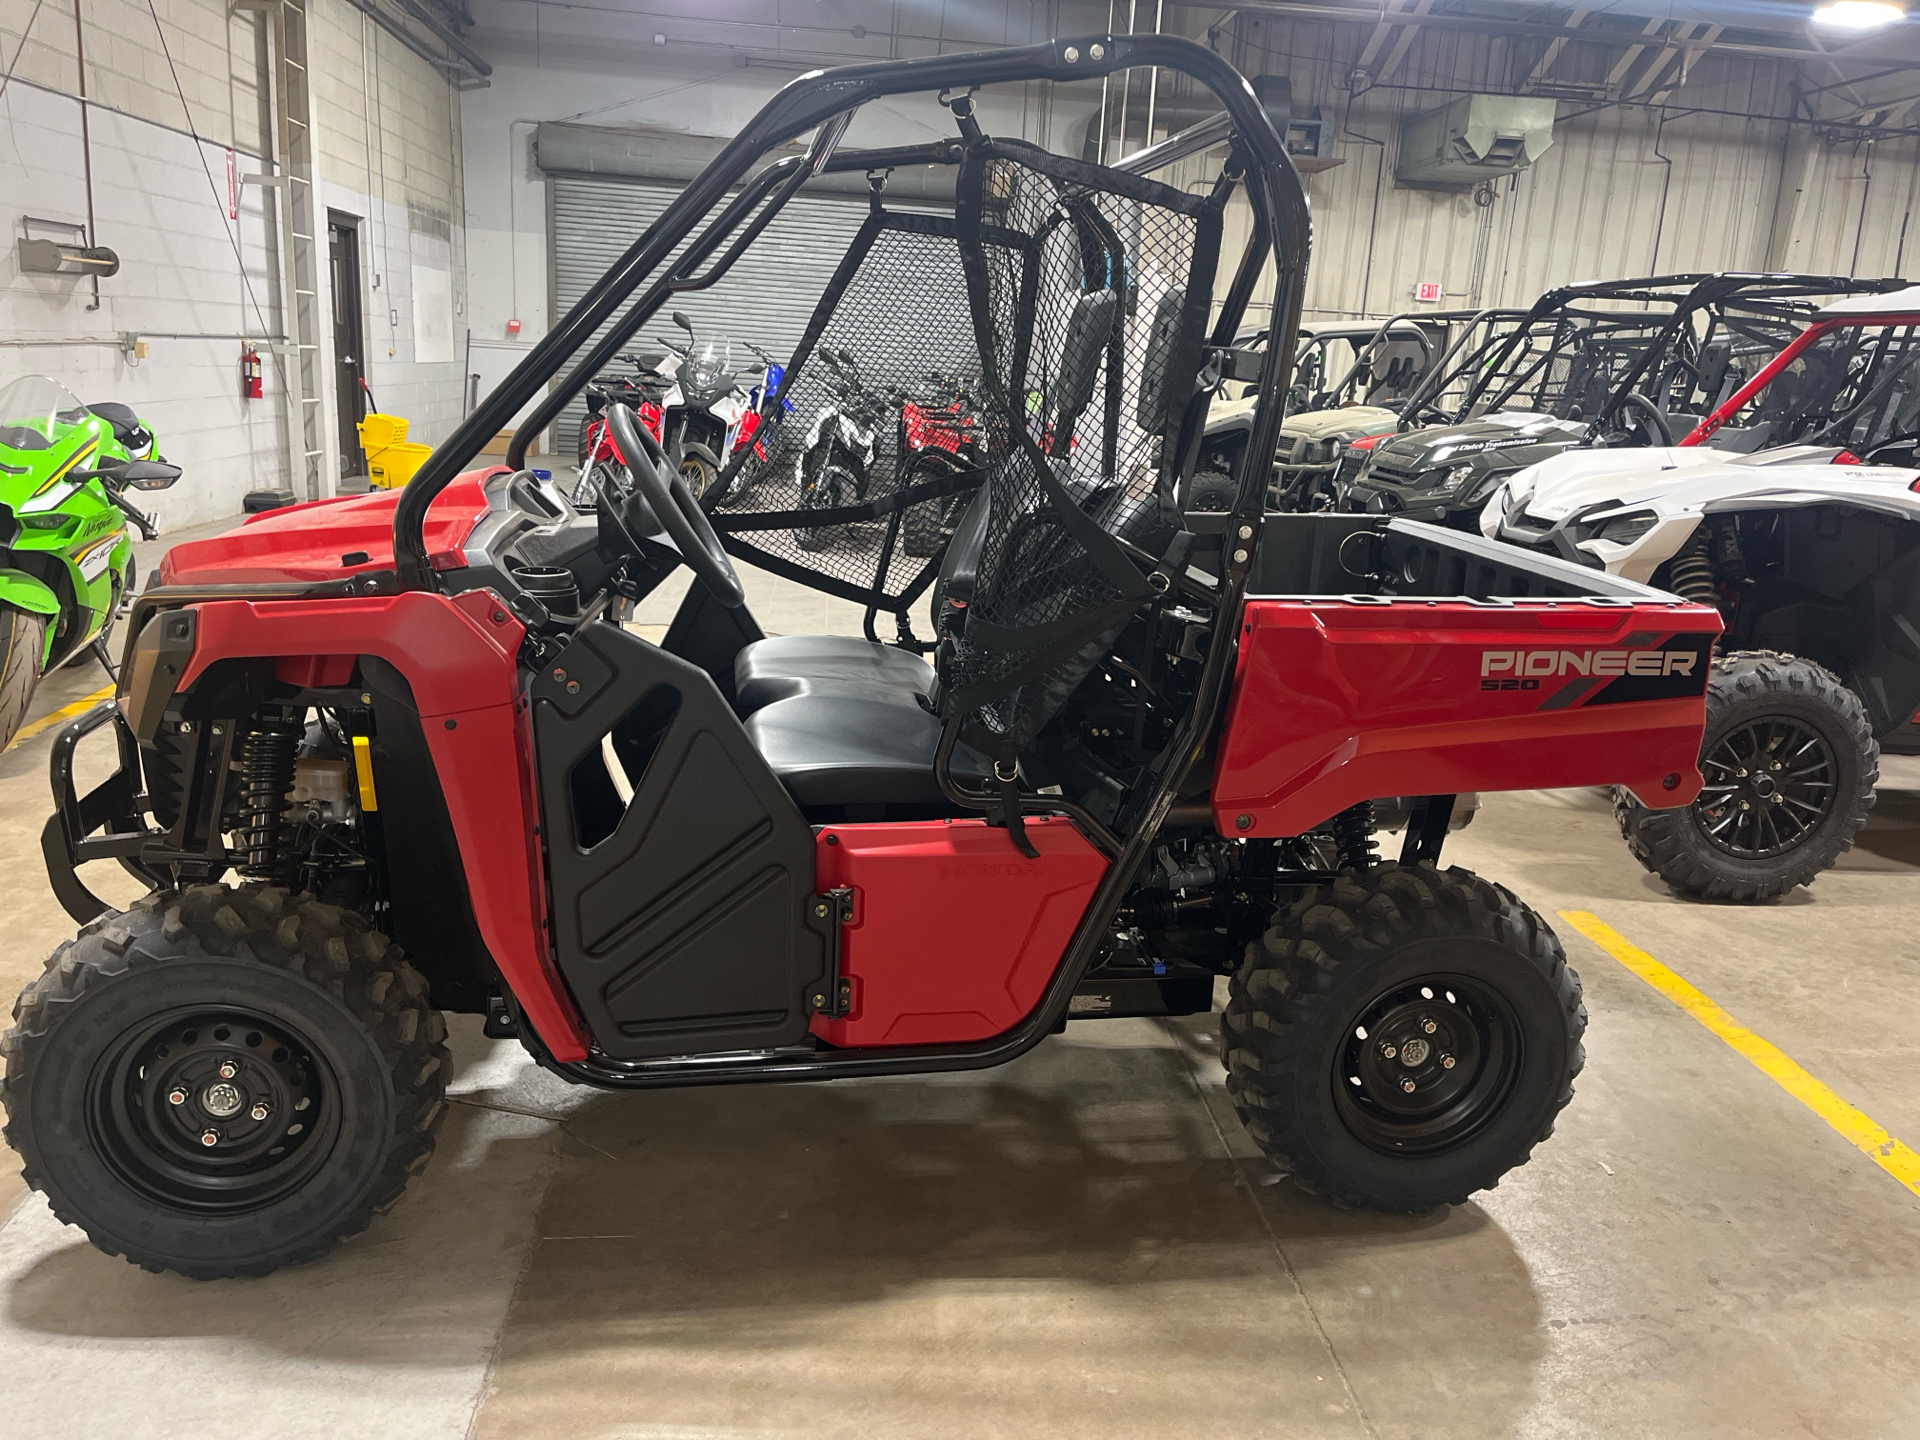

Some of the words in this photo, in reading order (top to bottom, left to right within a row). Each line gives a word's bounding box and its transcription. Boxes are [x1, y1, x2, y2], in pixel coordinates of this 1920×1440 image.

[1420, 283, 1439, 299] EXIT
[1459, 443, 1484, 451] Clutch
[1485, 438, 1538, 448] Transmission
[1480, 650, 1698, 677] PIONEER
[1480, 679, 1540, 691] 520
